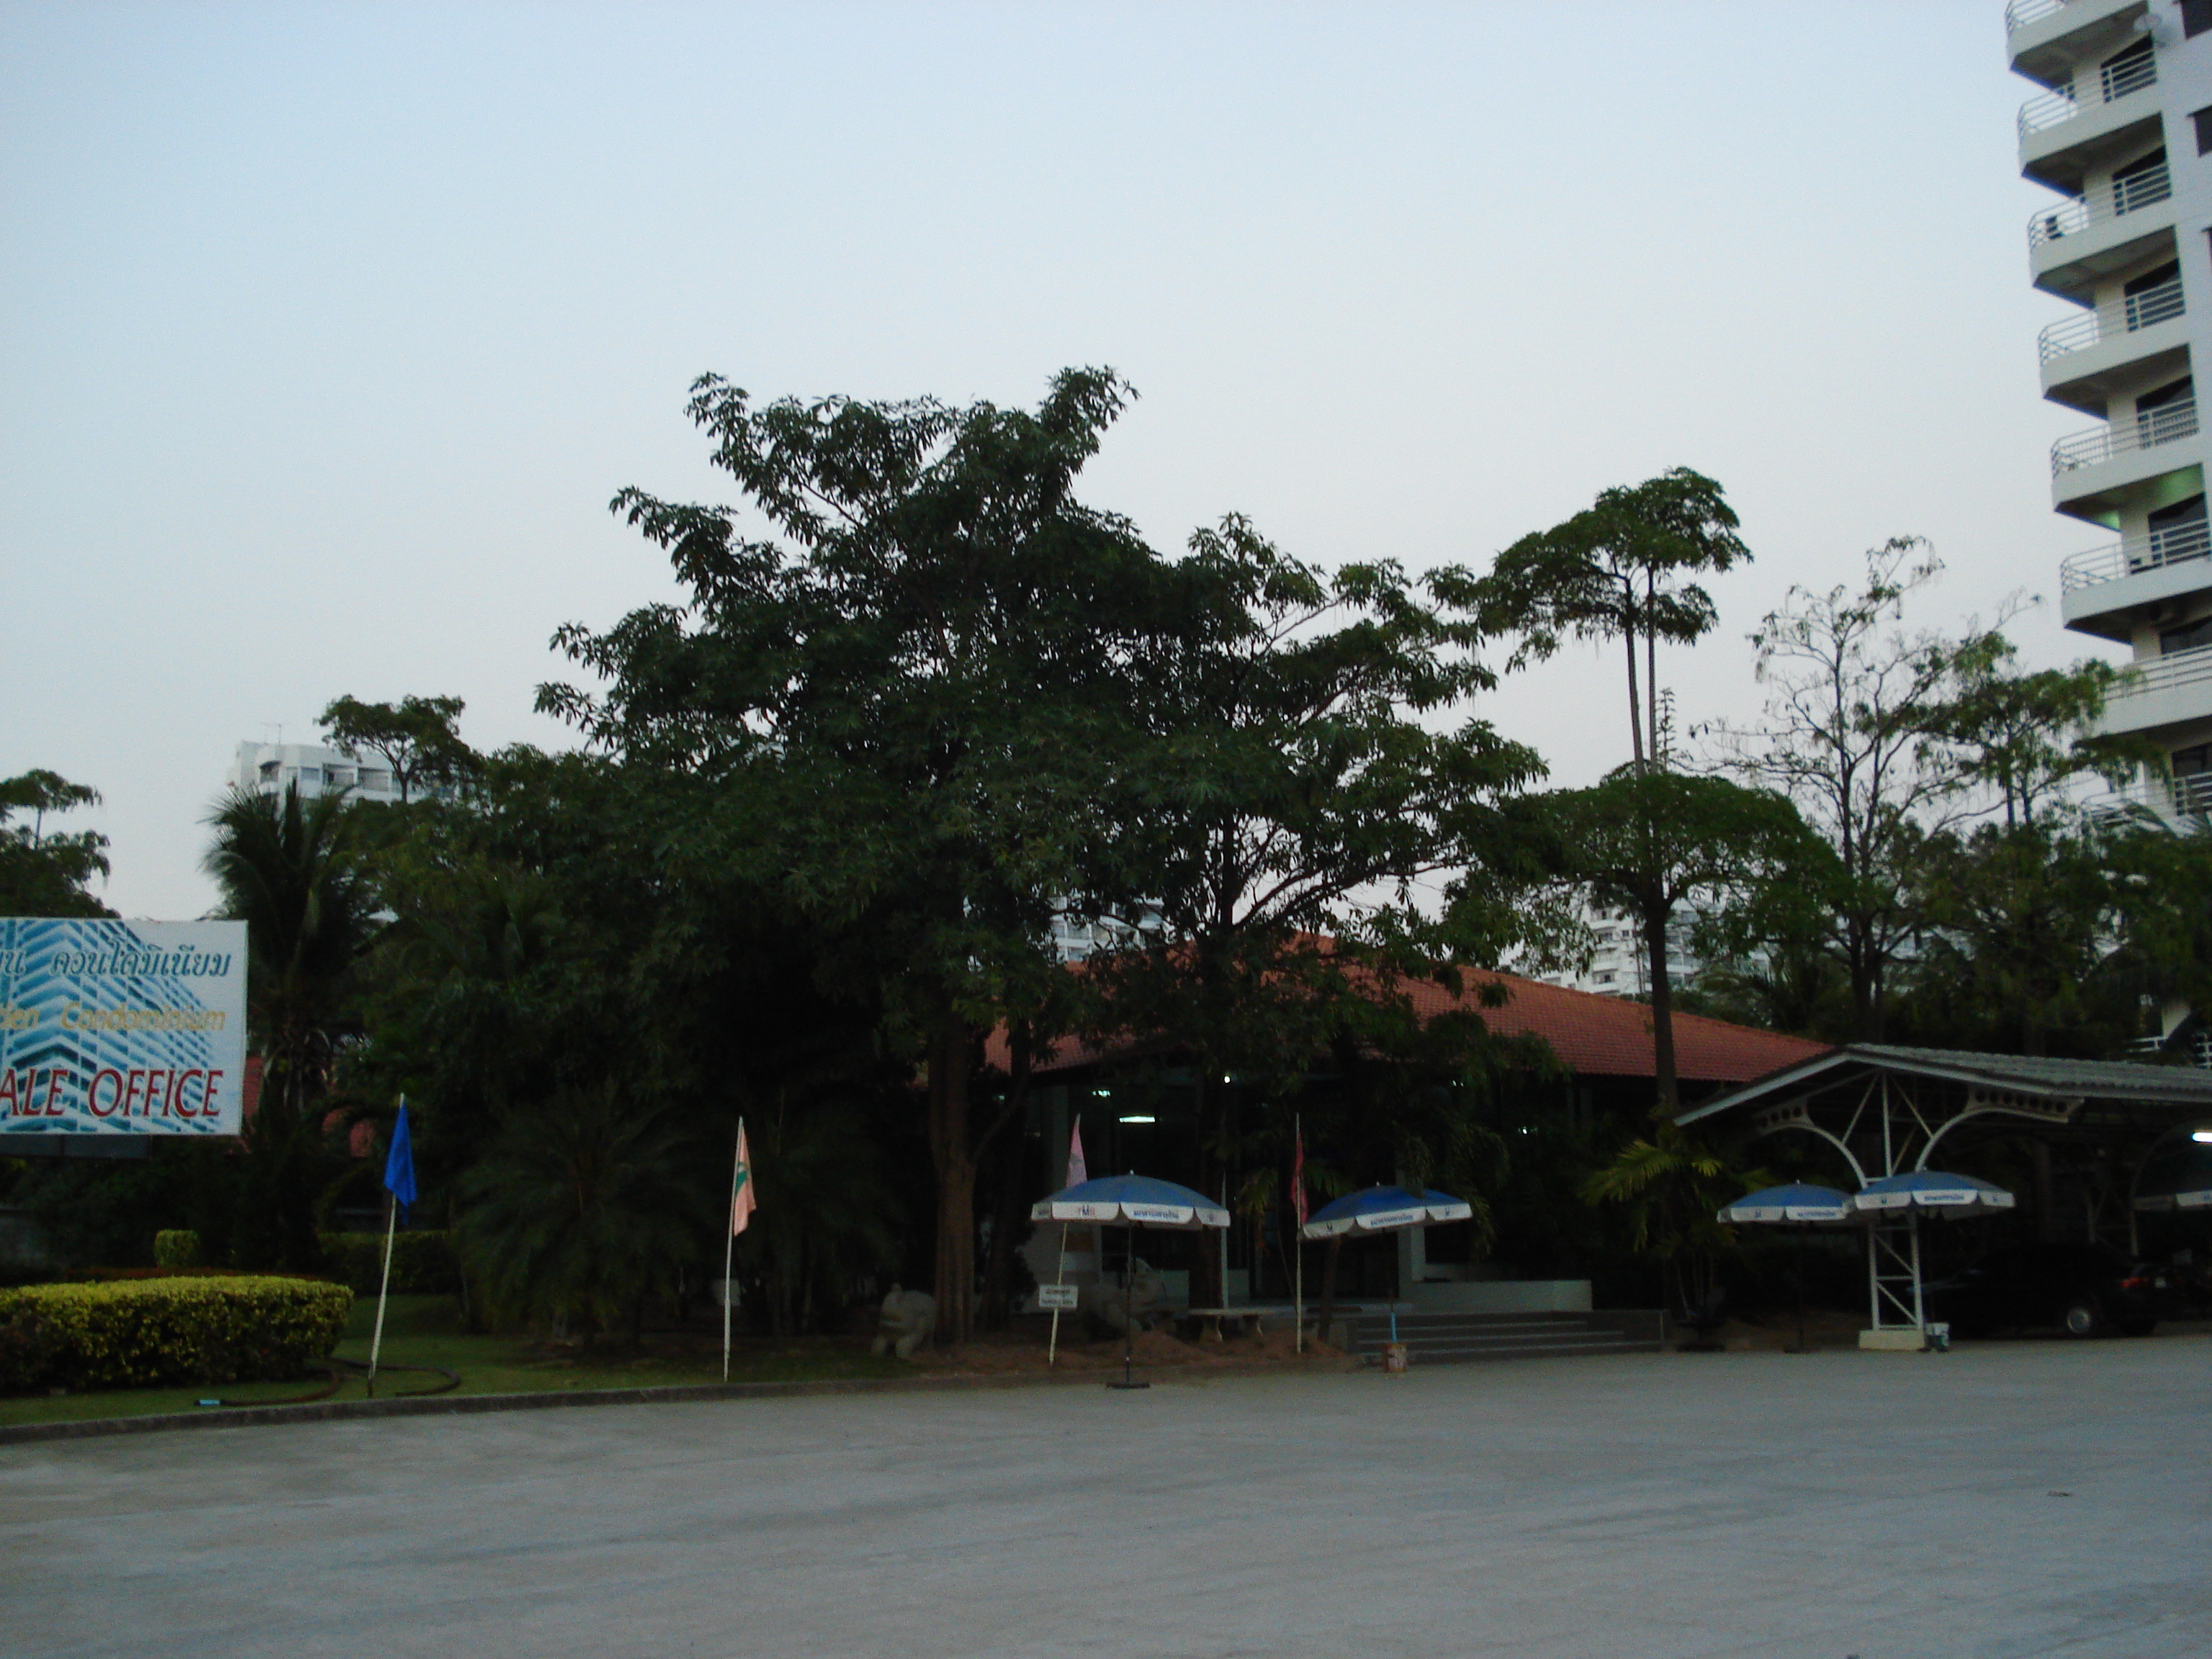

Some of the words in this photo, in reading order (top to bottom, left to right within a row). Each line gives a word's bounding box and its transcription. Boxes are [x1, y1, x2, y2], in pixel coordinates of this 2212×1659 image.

[60, 1002, 226, 1030] Condominium
[0, 1069, 68, 1115] ALE
[88, 1069, 223, 1117] OFFICE
